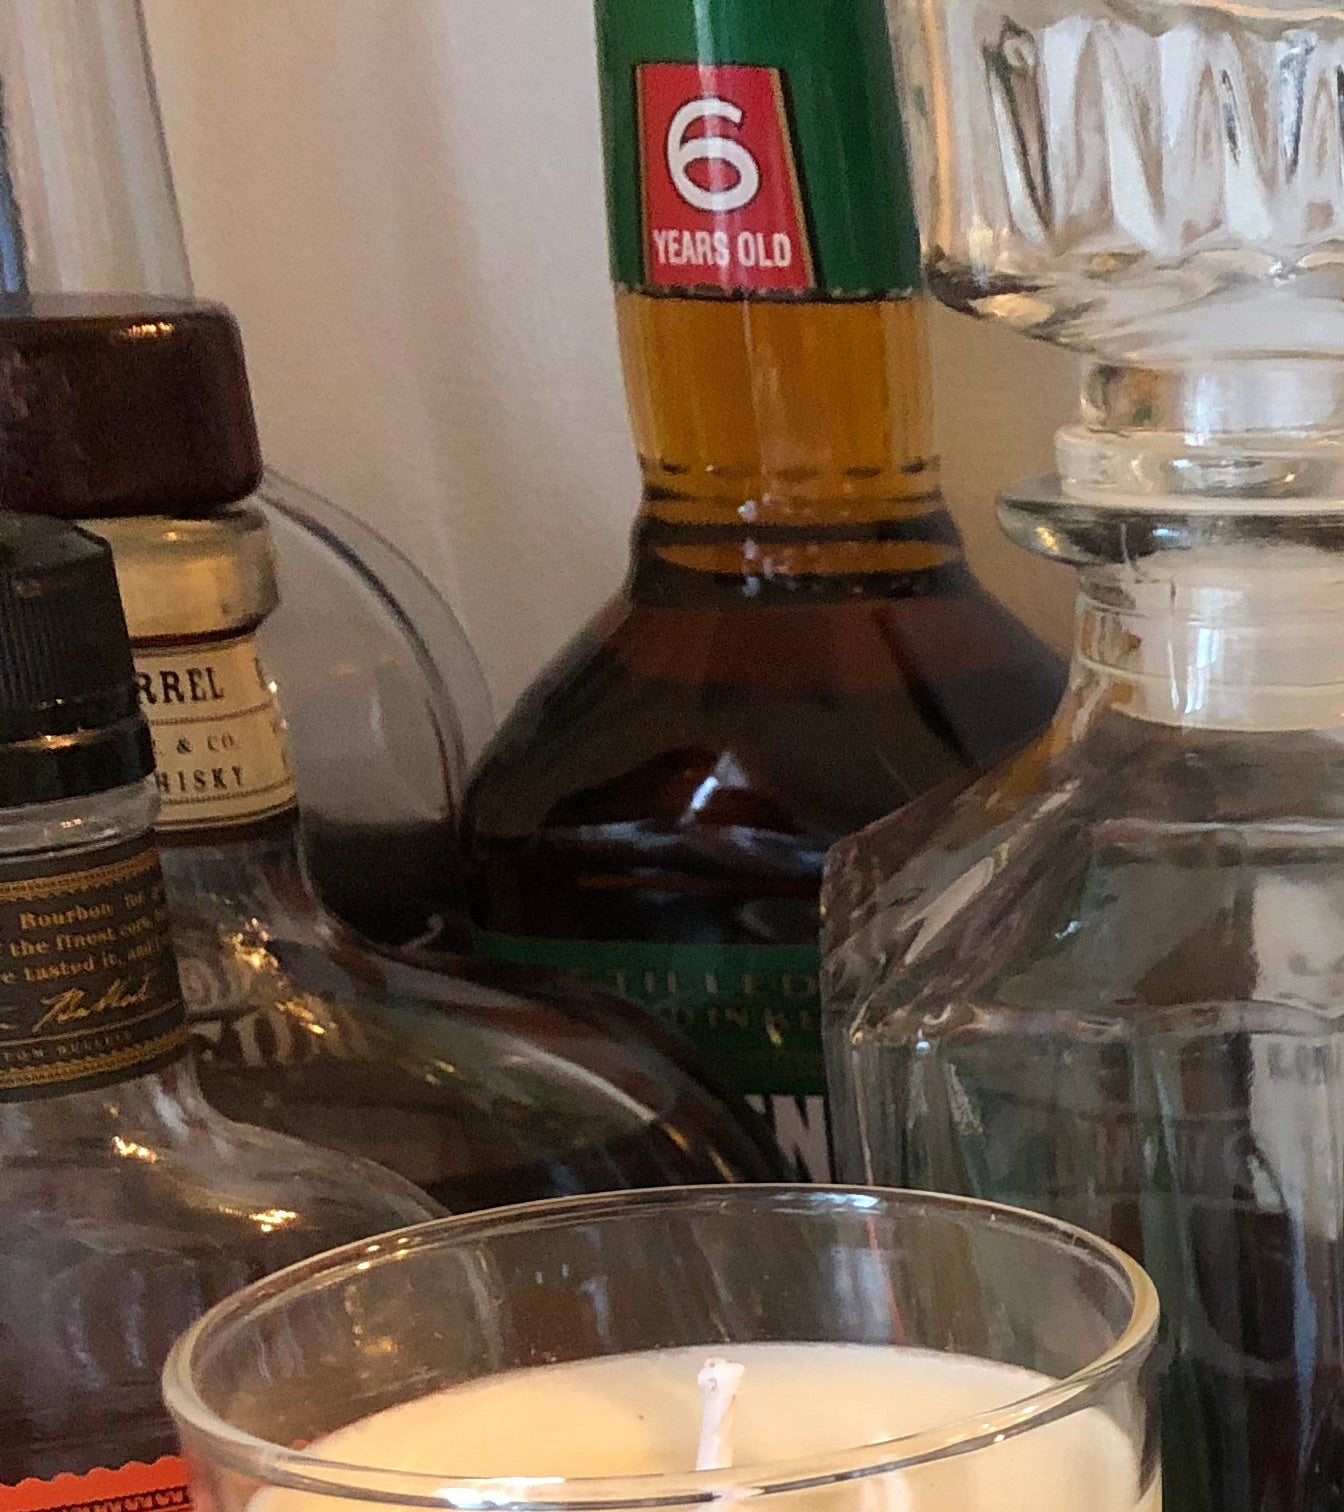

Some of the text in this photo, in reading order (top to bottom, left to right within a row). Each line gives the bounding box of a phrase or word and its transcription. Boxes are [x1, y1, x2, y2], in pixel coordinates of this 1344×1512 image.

[666, 96, 760, 213] 6
[652, 229, 792, 268] YEARS OLD
[20, 903, 115, 931] Bourbon
[9, 938, 50, 958] the
[56, 926, 117, 951] finest
[24, 956, 96, 982] tasted
